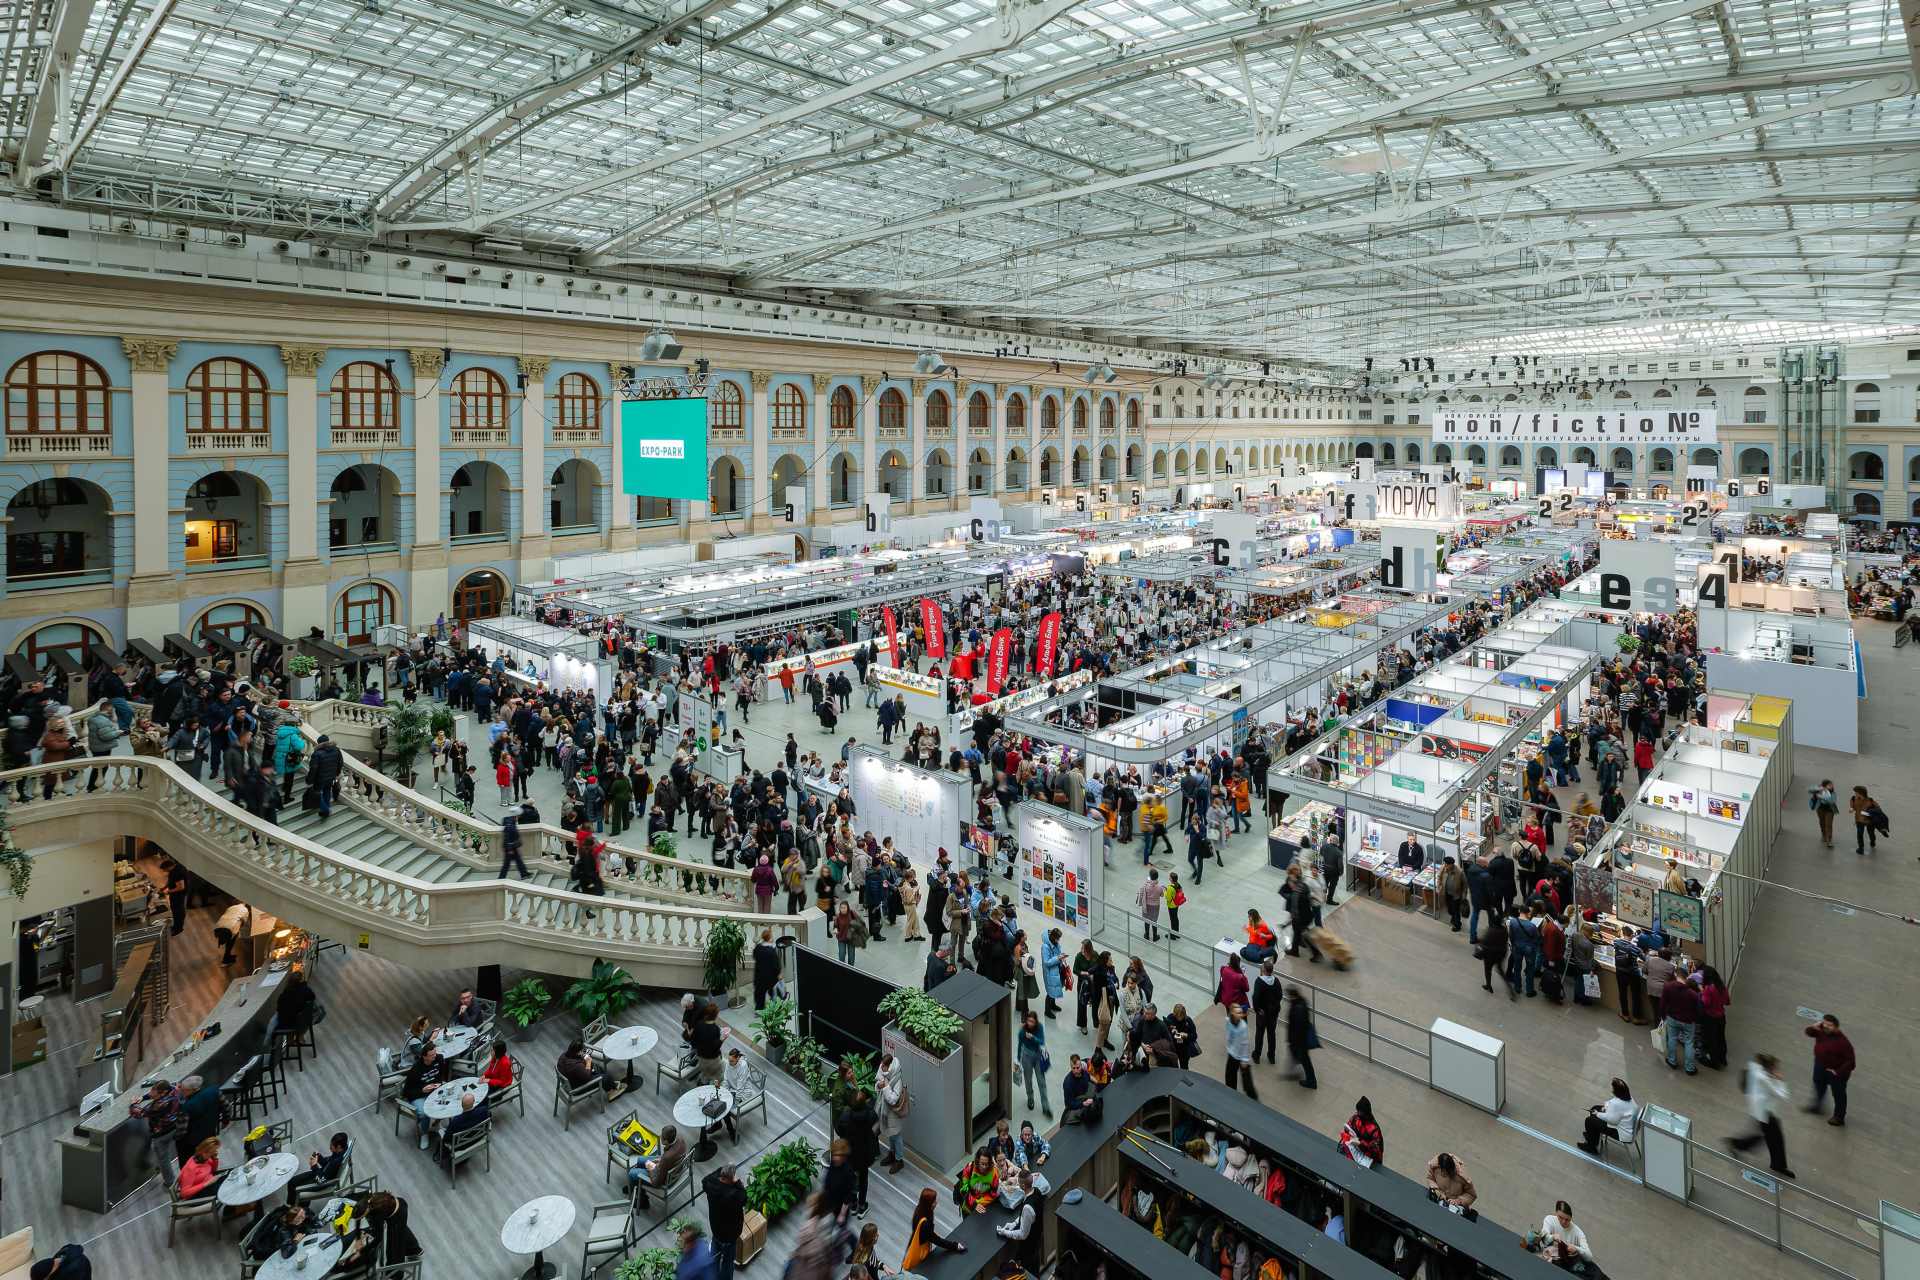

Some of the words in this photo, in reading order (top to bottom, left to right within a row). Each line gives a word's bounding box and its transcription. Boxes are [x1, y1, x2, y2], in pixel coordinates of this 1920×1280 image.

[1100, 488, 1107, 503] 5
[1132, 489, 1140, 505] 5
[1728, 482, 1739, 497] 6
[1757, 480, 1768, 494] 6
[1076, 495, 1085, 512] 5
[1376, 485, 1437, 518] ТОРИЯ
[1539, 499, 1552, 518] 2
[1561, 493, 1572, 511] 2
[785, 503, 794, 521] a
[866, 503, 876, 532] b
[1683, 505, 1697, 527] 2
[971, 518, 983, 540] c
[1213, 538, 1230, 565] c
[1380, 546, 1403, 588] d
[1600, 573, 1631, 610] e
[1700, 573, 1726, 609] 4
